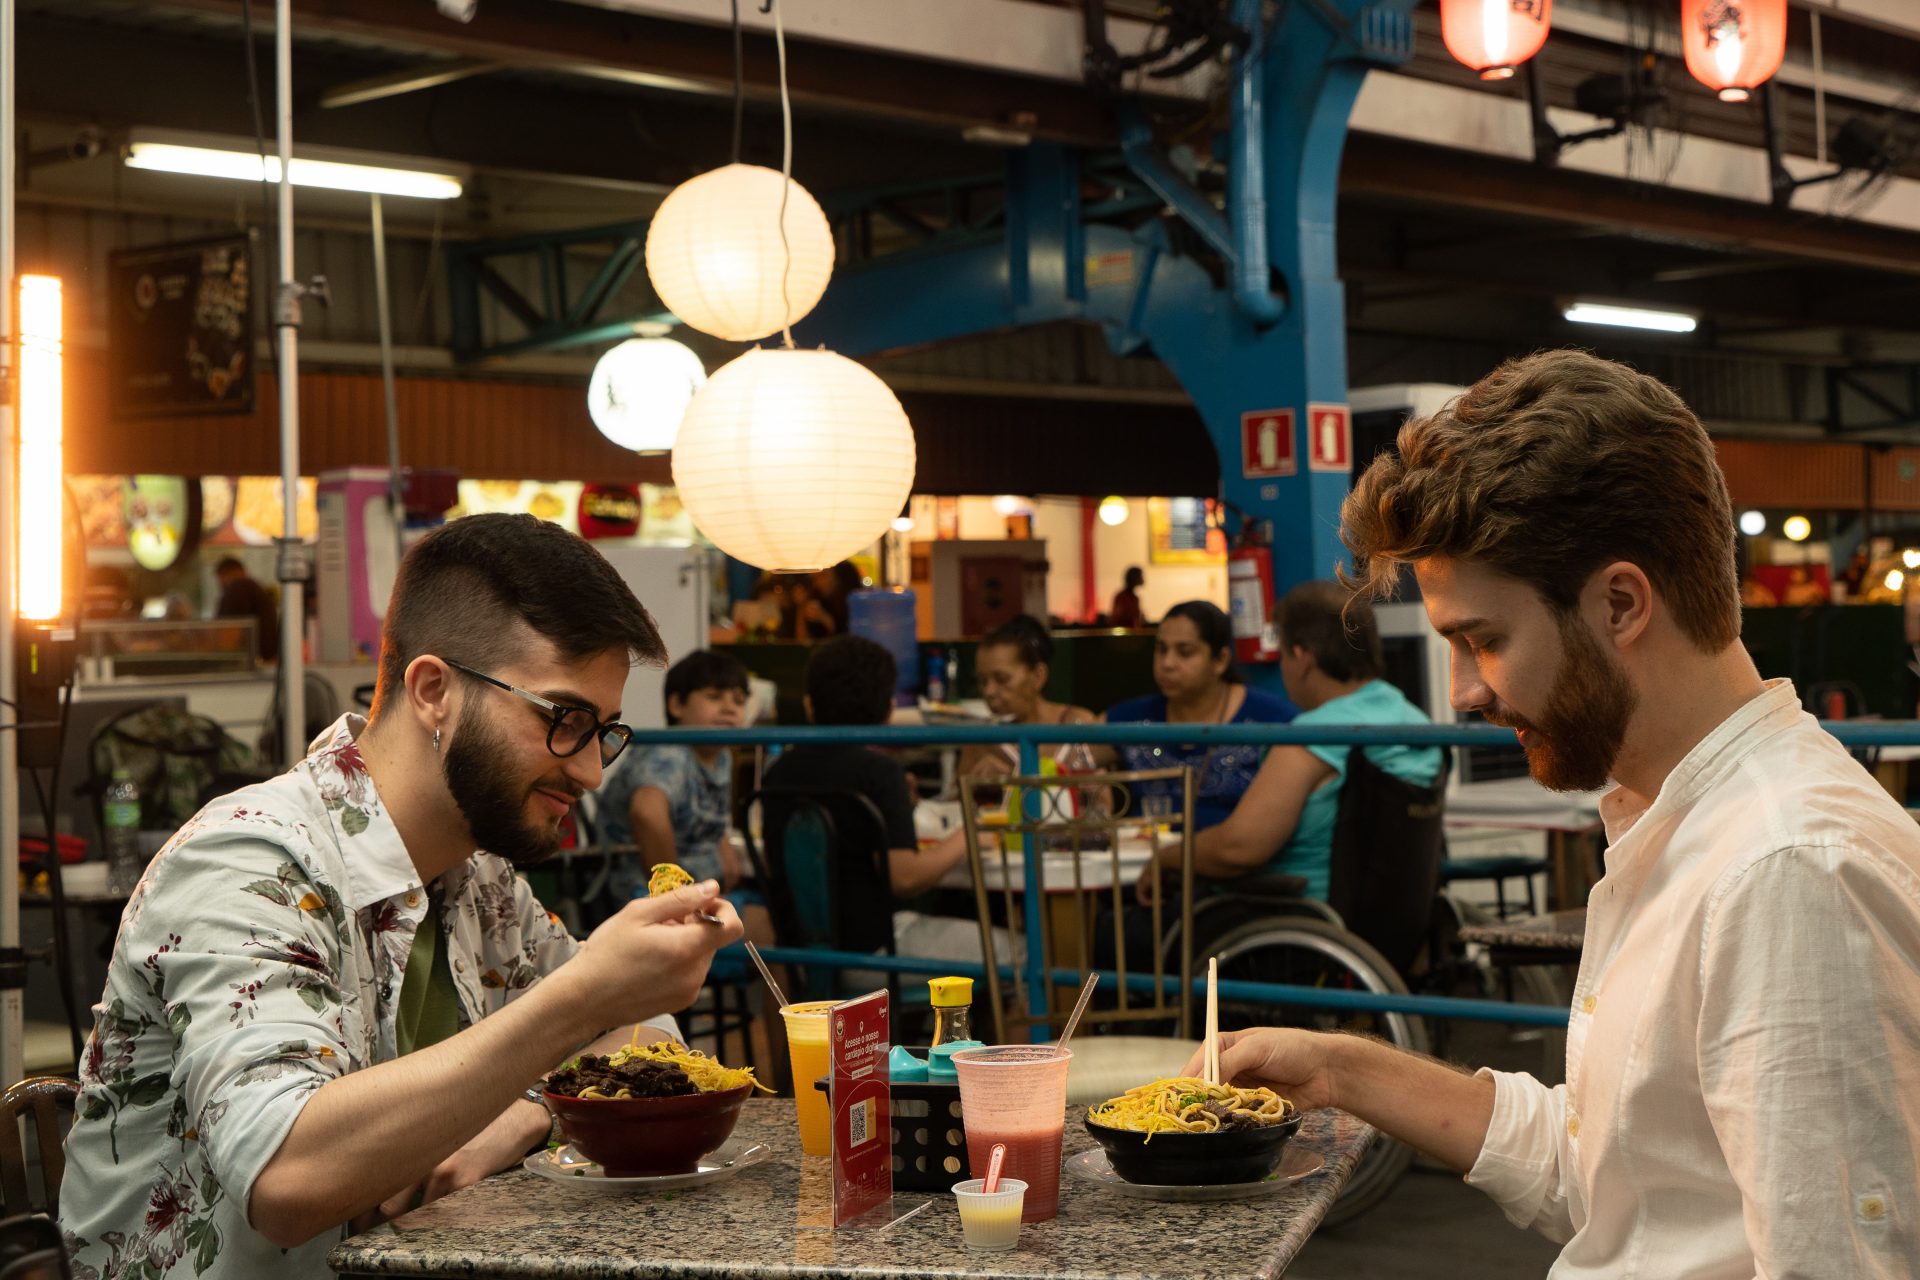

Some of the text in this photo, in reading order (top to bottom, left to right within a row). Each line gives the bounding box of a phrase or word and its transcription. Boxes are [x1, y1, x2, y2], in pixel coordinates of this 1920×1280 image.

[845, 1036, 860, 1049] Acesse
[865, 1030, 879, 1042] nosso
[865, 1040, 879, 1054] digital
